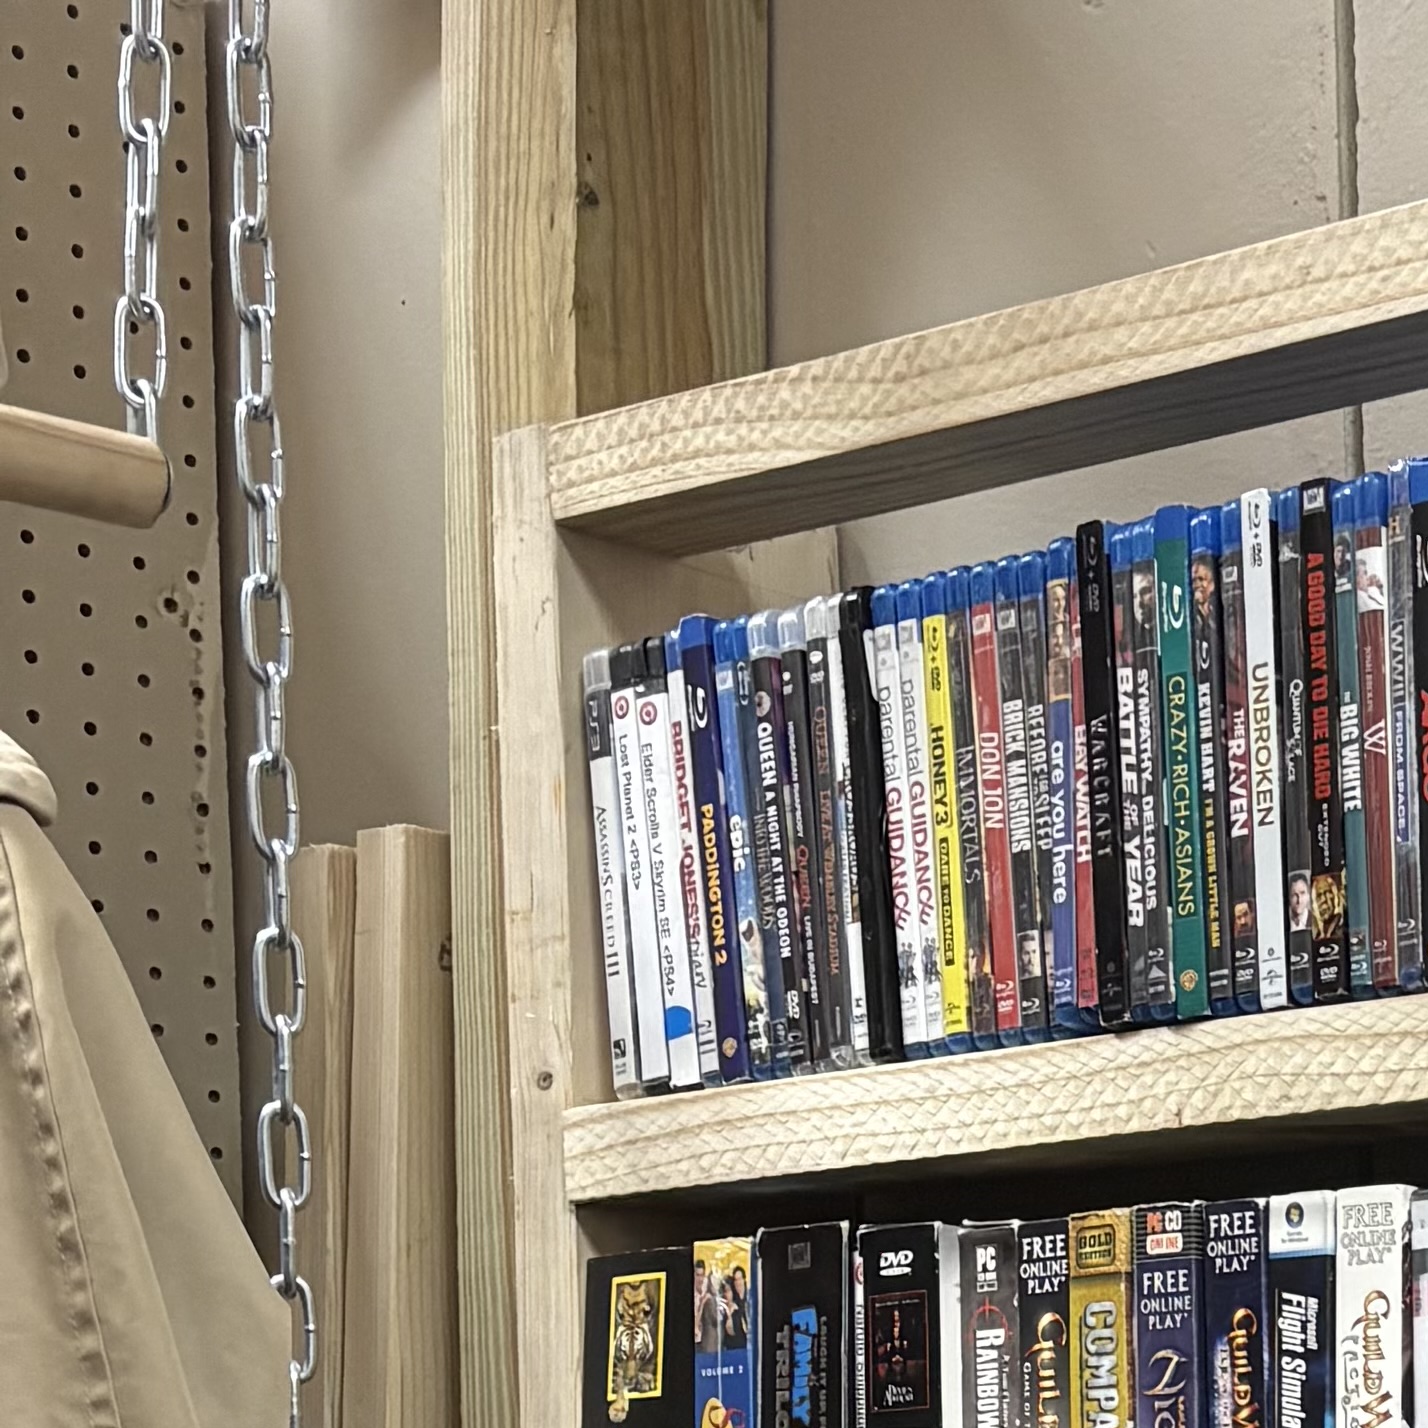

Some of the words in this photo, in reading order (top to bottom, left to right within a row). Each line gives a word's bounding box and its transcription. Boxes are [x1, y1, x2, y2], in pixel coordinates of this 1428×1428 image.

[1252, 662, 1274, 828] UNBROKEN
[700, 804, 725, 947] PADDINGTON
[715, 950, 727, 965] 2
[1020, 1259, 1068, 1277] ONLINE
[1021, 1238, 1065, 1260] FREE
